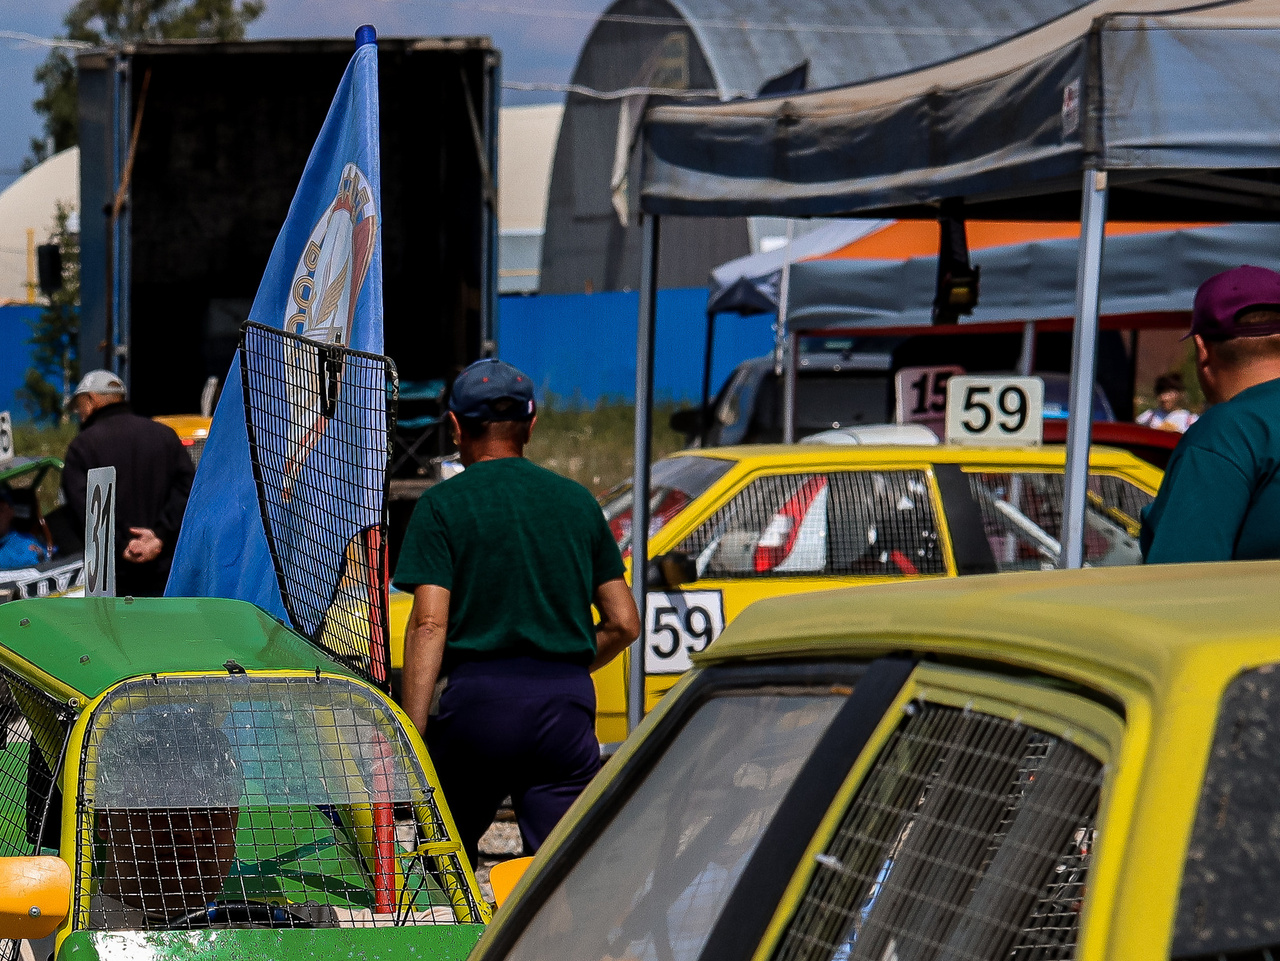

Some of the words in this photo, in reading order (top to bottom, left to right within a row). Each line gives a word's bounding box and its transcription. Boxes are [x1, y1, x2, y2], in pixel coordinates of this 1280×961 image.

[962, 386, 1027, 433] 59
[87, 482, 113, 593] 31
[651, 605, 713, 659] 59
